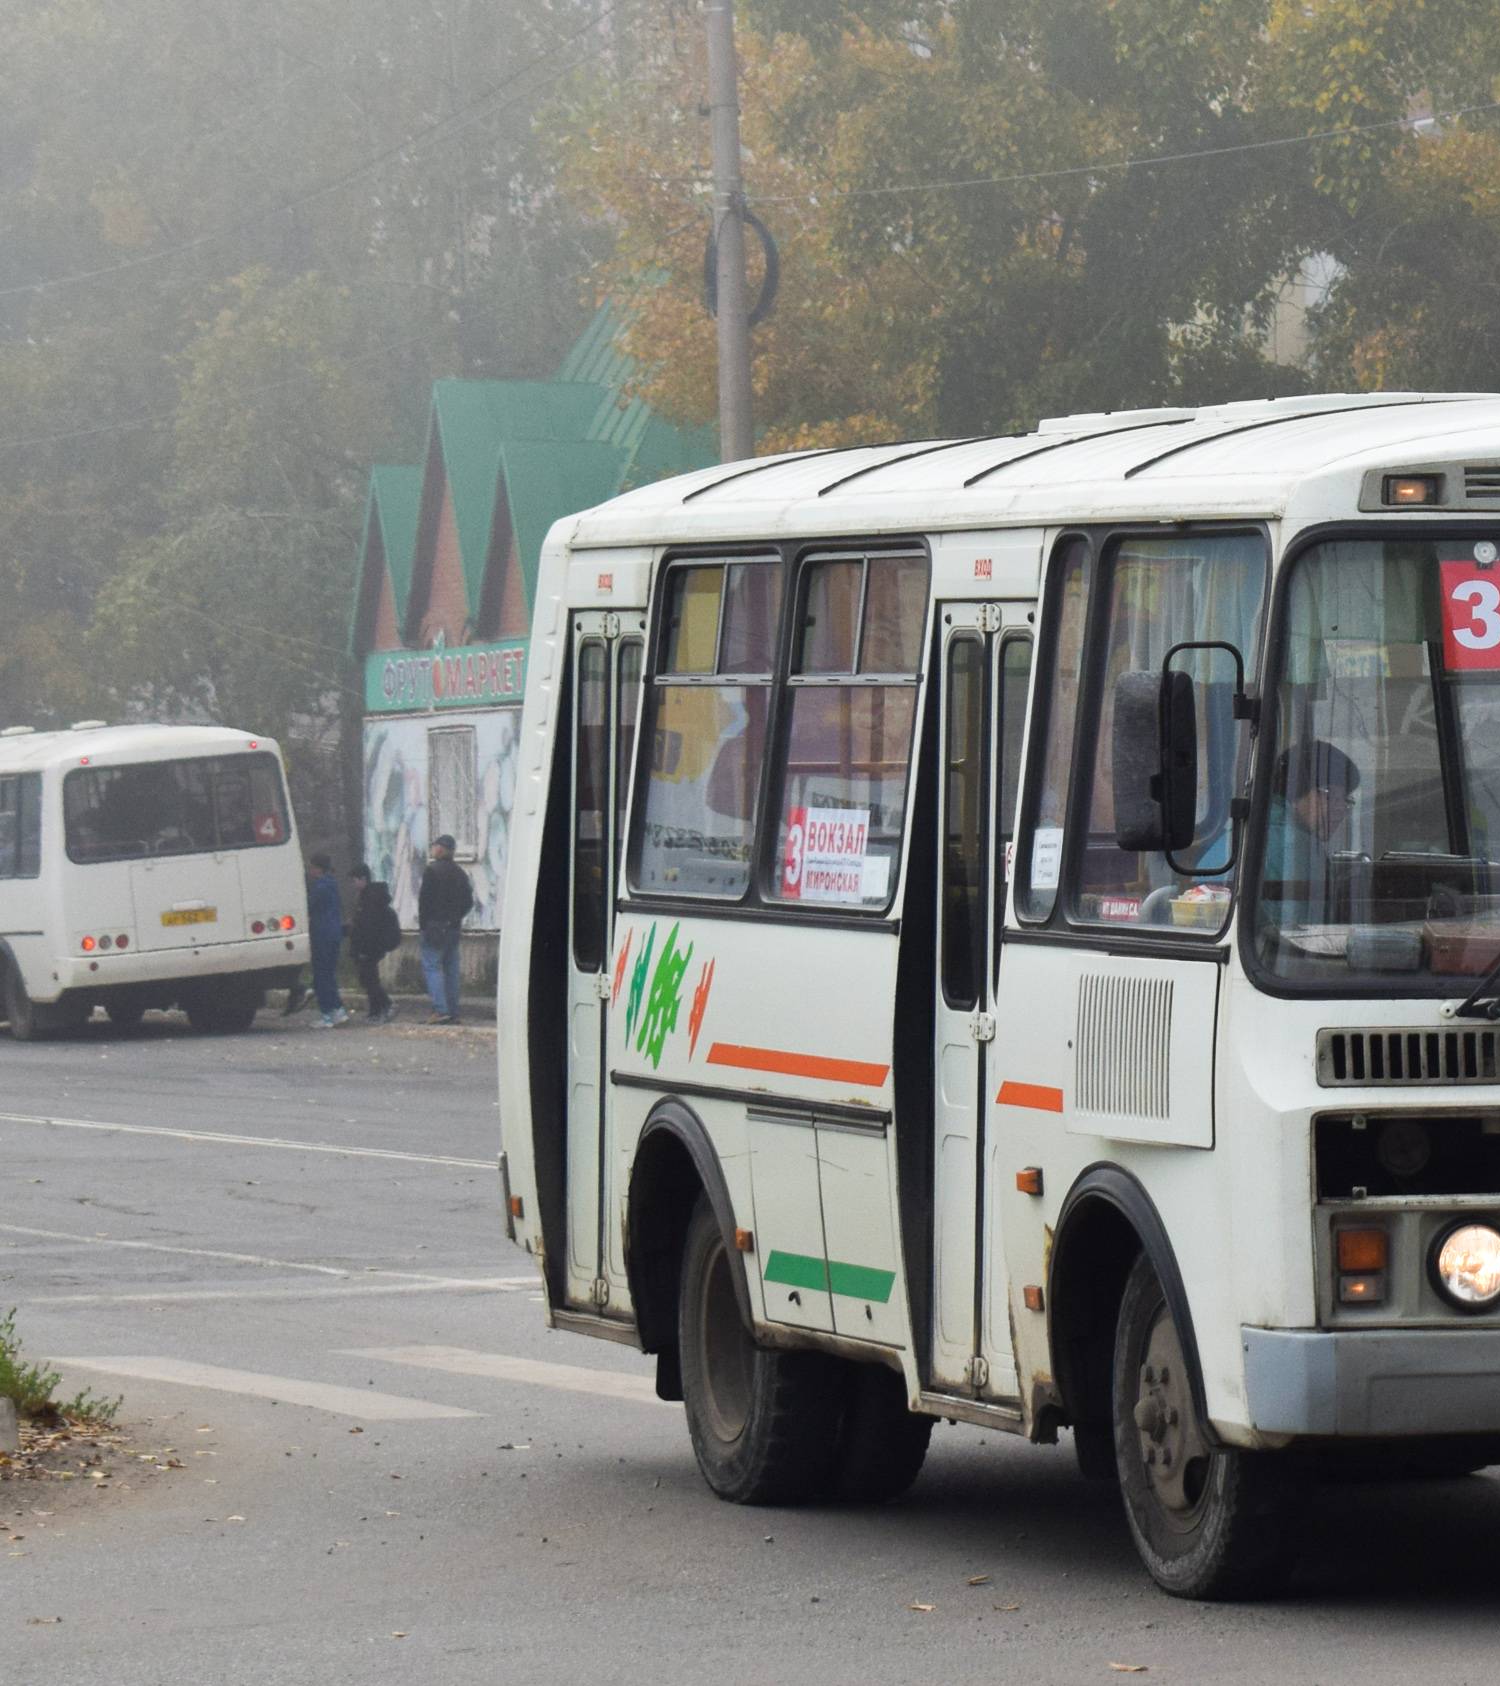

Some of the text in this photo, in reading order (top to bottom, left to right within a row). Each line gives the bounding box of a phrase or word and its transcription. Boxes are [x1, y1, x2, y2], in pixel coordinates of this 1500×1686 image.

[974, 558, 992, 580] ВХОД
[260, 818, 277, 837] 4
[807, 821, 866, 856] ВОКЗАЛ
[784, 823, 805, 886] 3
[805, 870, 860, 893] МИРОНСКАЯ
